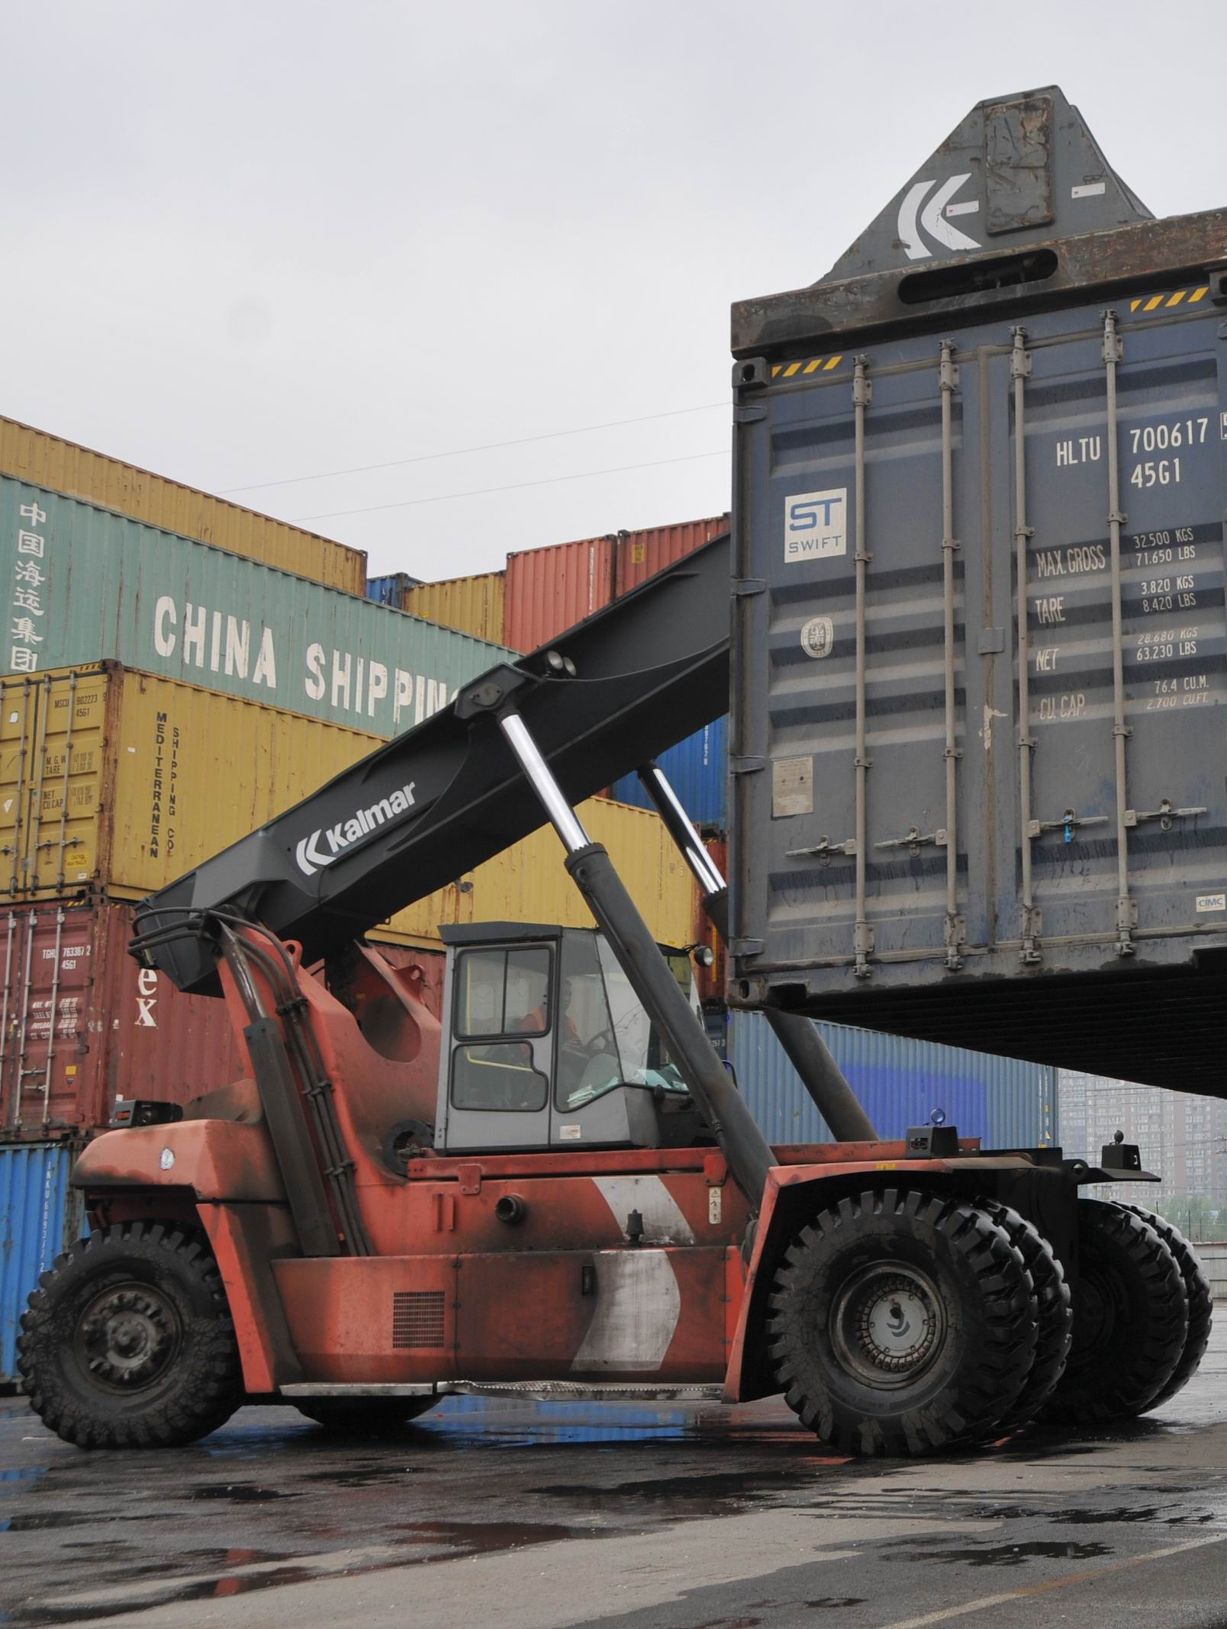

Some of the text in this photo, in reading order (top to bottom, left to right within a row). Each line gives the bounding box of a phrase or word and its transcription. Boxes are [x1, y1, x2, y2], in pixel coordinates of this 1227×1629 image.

[1056, 436, 1100, 466] HLTU
[1130, 418, 1209, 454] 700617
[1131, 458, 1180, 488] 45G1
[789, 497, 842, 531] ST
[788, 535, 842, 553] SWIFT
[1134, 531, 1170, 549] 32.500
[1176, 527, 1194, 543] KGS
[1136, 545, 1196, 567] 71.650 LBS
[11, 503, 47, 673] 中国海运集团
[1035, 575, 1195, 624] TARE 3.820 KGS
[1143, 592, 1197, 613] 8.420 LBS
[154, 596, 461, 725] CHINA SHIPPIN
[1035, 648, 1060, 671] NET
[1180, 626, 1199, 639] KGS
[1136, 641, 1197, 661] 63.230 LBS
[1154, 678, 1178, 694] 76.4
[150, 712, 168, 858] MEDITERRANEAN
[168, 727, 180, 816] SHIPPING
[325, 781, 416, 853] Kalmar
